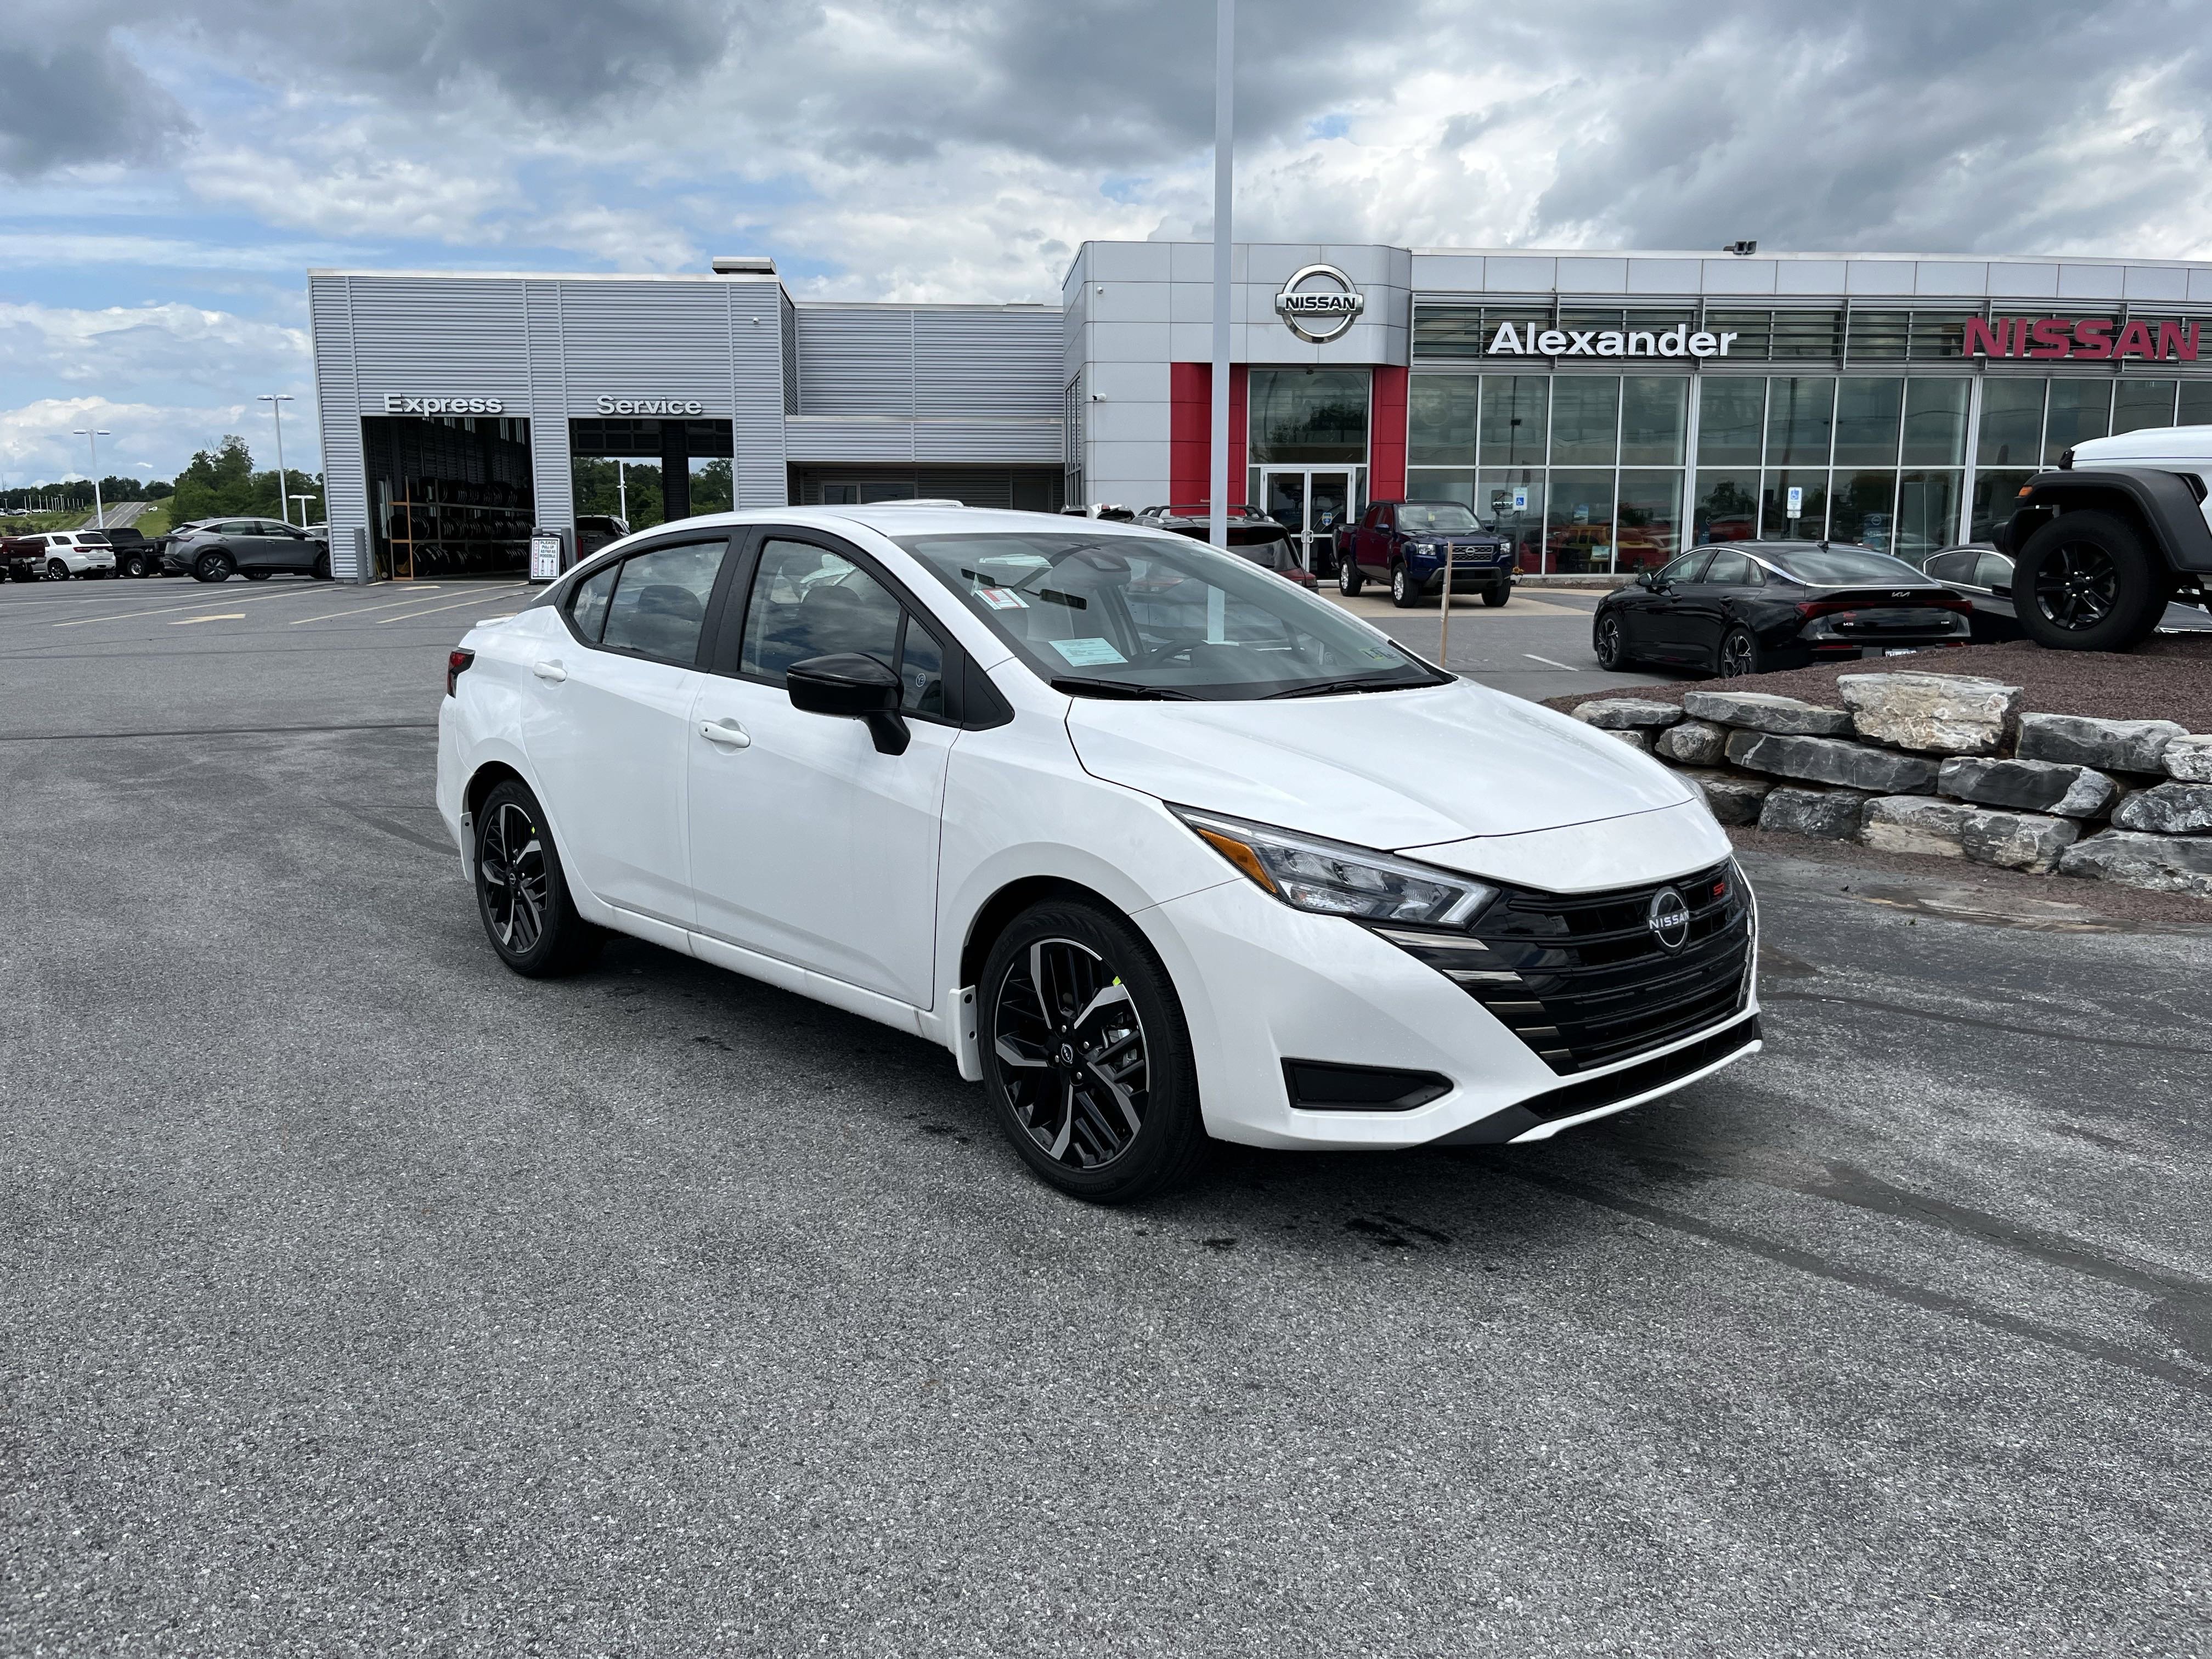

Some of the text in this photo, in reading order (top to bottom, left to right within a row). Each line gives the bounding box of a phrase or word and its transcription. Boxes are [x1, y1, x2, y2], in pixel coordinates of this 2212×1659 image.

[1285, 296, 1356, 311] NISSAN
[1487, 322, 1737, 357] Alexander
[1963, 317, 2200, 360] NISSAN
[384, 393, 503, 416] Express
[597, 394, 702, 414] Service
[1713, 882, 1725, 895] SR
[1649, 910, 1689, 929] NISSAN
